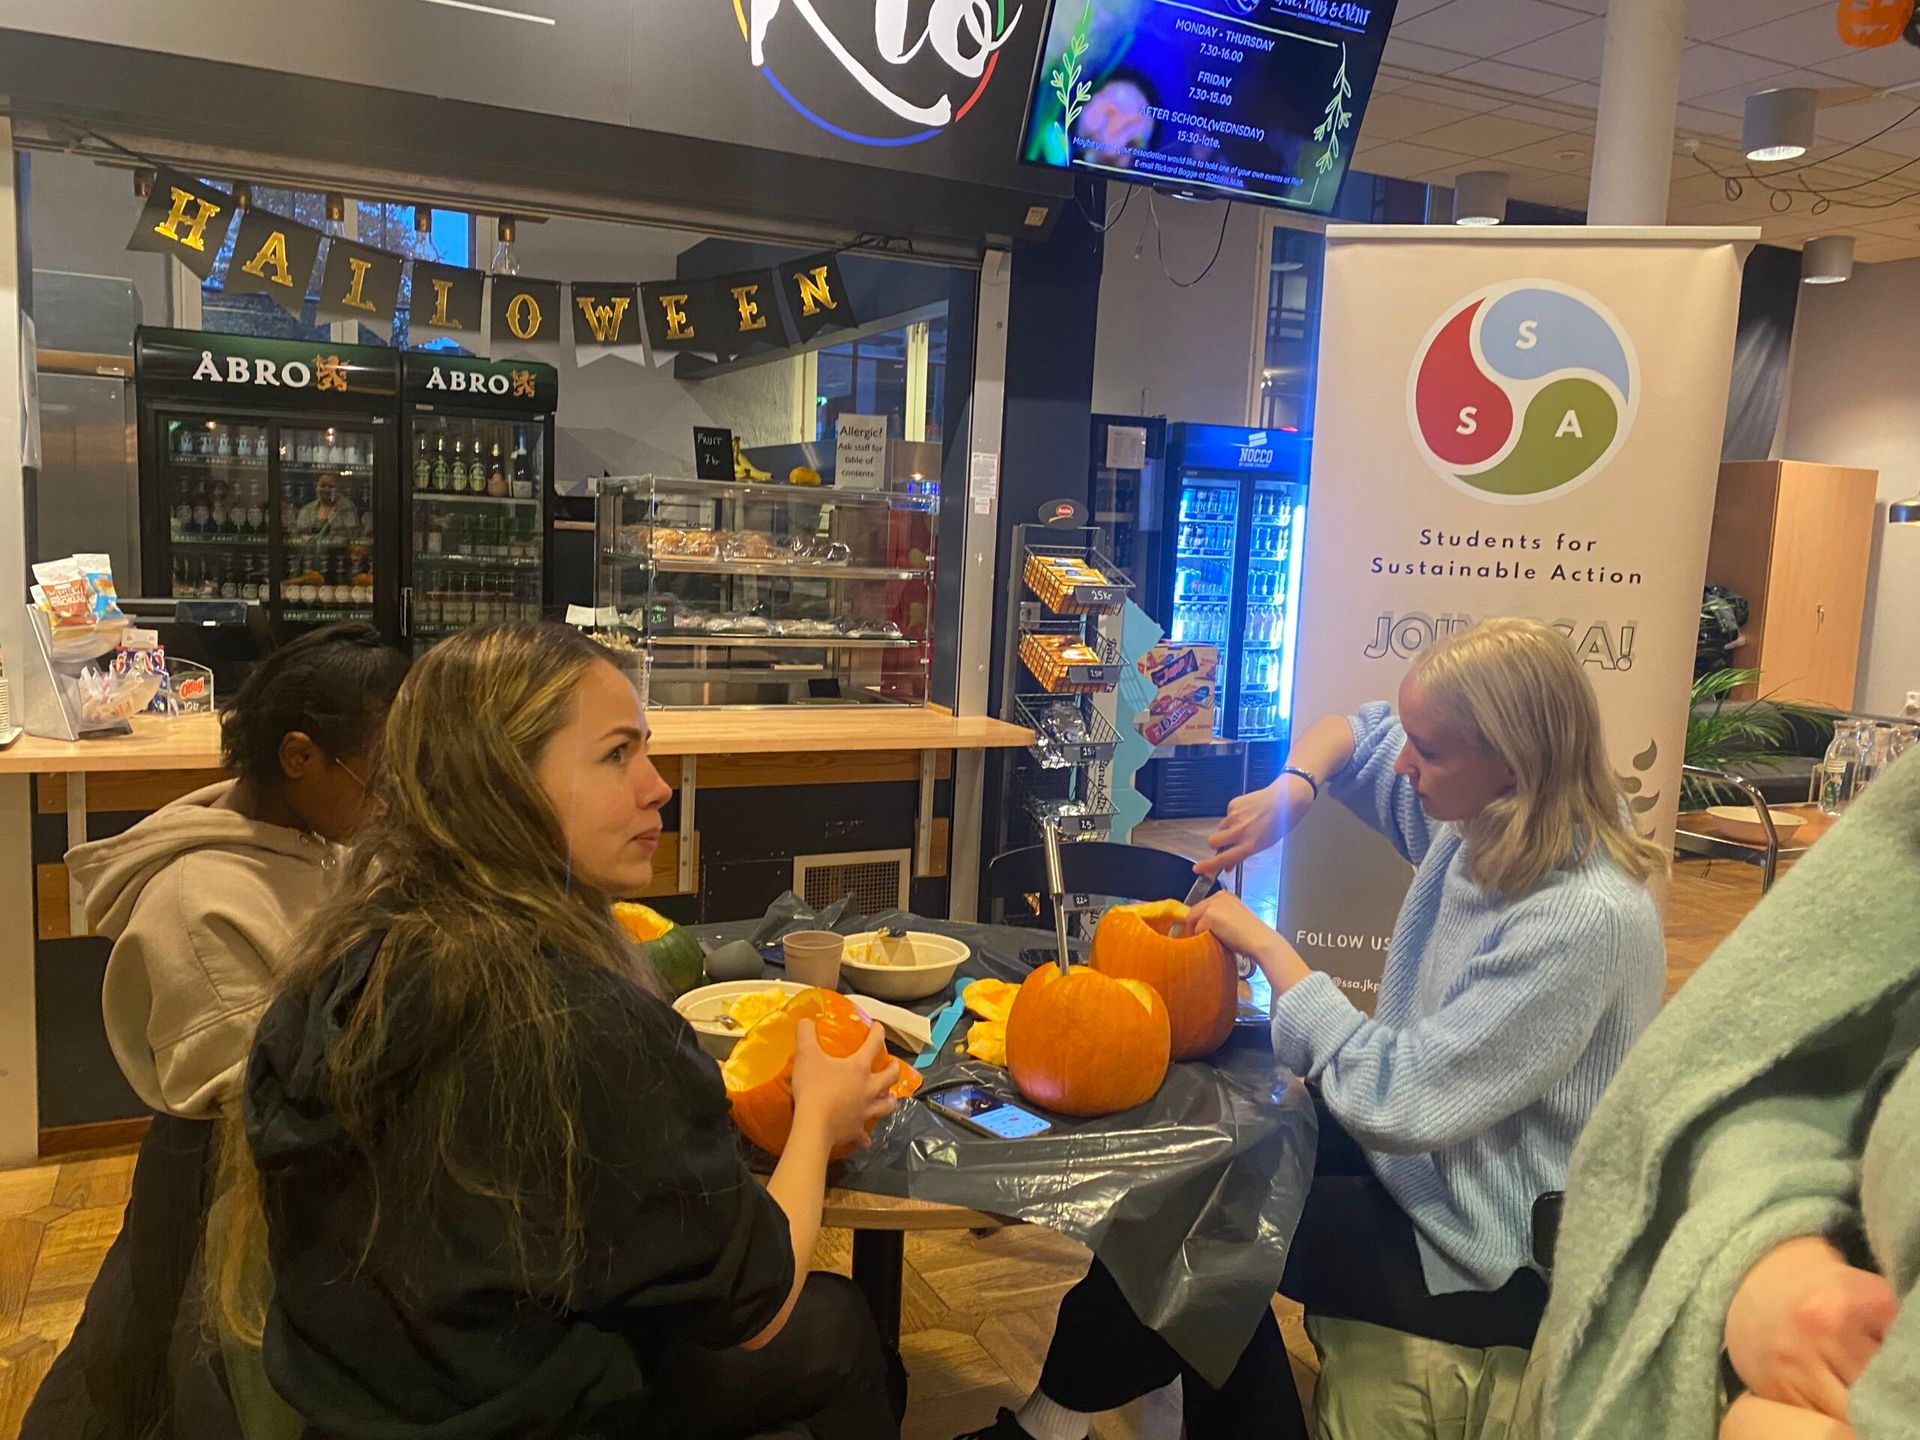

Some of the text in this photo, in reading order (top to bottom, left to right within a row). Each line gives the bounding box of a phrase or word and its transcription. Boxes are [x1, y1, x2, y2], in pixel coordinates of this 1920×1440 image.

[1176, 18, 1218, 39] MONDAY
[1225, 30, 1275, 52] THURSDAY
[1199, 43, 1244, 64] 7.30-16.00
[1197, 71, 1232, 88] FRIDAY
[1188, 86, 1232, 106] 7.30-15.00
[1141, 106, 1169, 121] AFTER
[1515, 320, 1538, 350] S
[192, 351, 311, 389] ÅBRO
[426, 366, 510, 396] ÅBRO
[1455, 406, 1583, 438] S A
[838, 442, 883, 454] Ask staff for
[1239, 448, 1273, 464] NOCCO
[844, 456, 875, 466] table of
[841, 470, 875, 479] contents
[1419, 528, 1597, 552] Students for
[1371, 557, 1642, 585] Sustainable Action
[1552, 621, 1637, 672] A!
[1296, 930, 1364, 949] FOLLOW
